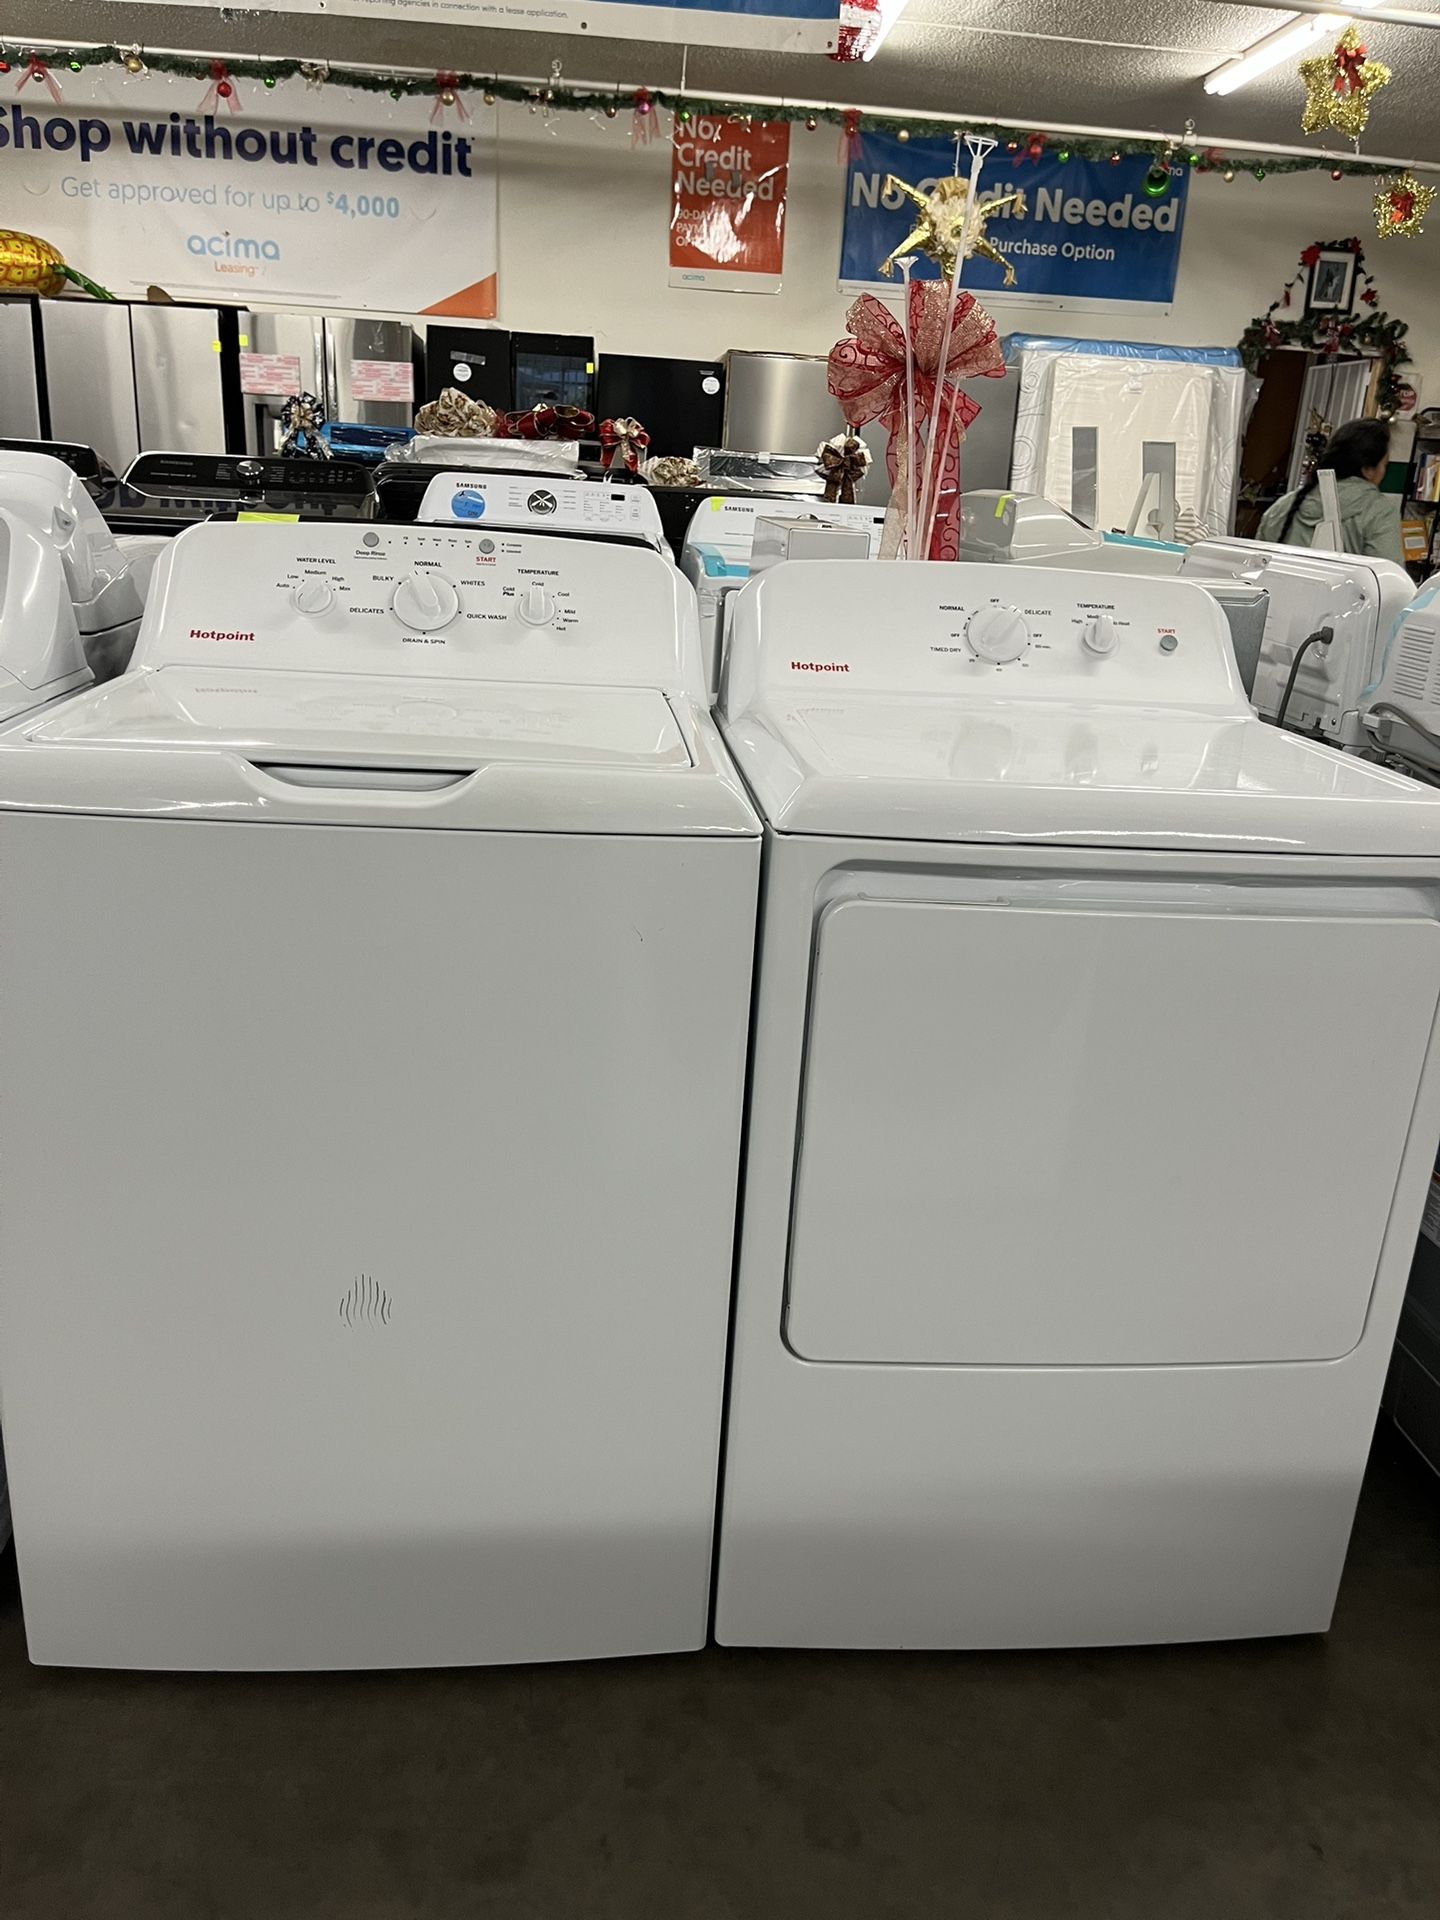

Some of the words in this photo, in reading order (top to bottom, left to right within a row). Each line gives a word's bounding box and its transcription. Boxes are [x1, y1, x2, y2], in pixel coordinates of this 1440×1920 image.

[440, 3, 480, 11] connection
[506, 7, 525, 15] lease
[0, 104, 111, 162] Shop
[123, 112, 318, 167] without
[678, 115, 715, 140] No
[677, 142, 752, 171] Credit
[61, 176, 100, 197] Get
[108, 182, 217, 206] approved
[225, 185, 255, 207] for
[262, 193, 291, 214] up
[298, 193, 320, 212] to
[327, 191, 400, 219] $4,000
[676, 170, 774, 200] Needed
[852, 172, 906, 210] No
[1034, 187, 1179, 232] Needed
[187, 232, 280, 260] acima
[990, 236, 1058, 257] Purchase
[1061, 242, 1116, 262] Option
[456, 482, 487, 490] SAMSUNG
[517, 568, 560, 576] TEMPERATURE
[349, 607, 385, 615] DELICATES
[466, 613, 487, 621] QUICK
[189, 629, 255, 641] Hotpoint
[791, 661, 850, 673] Hotpoint
